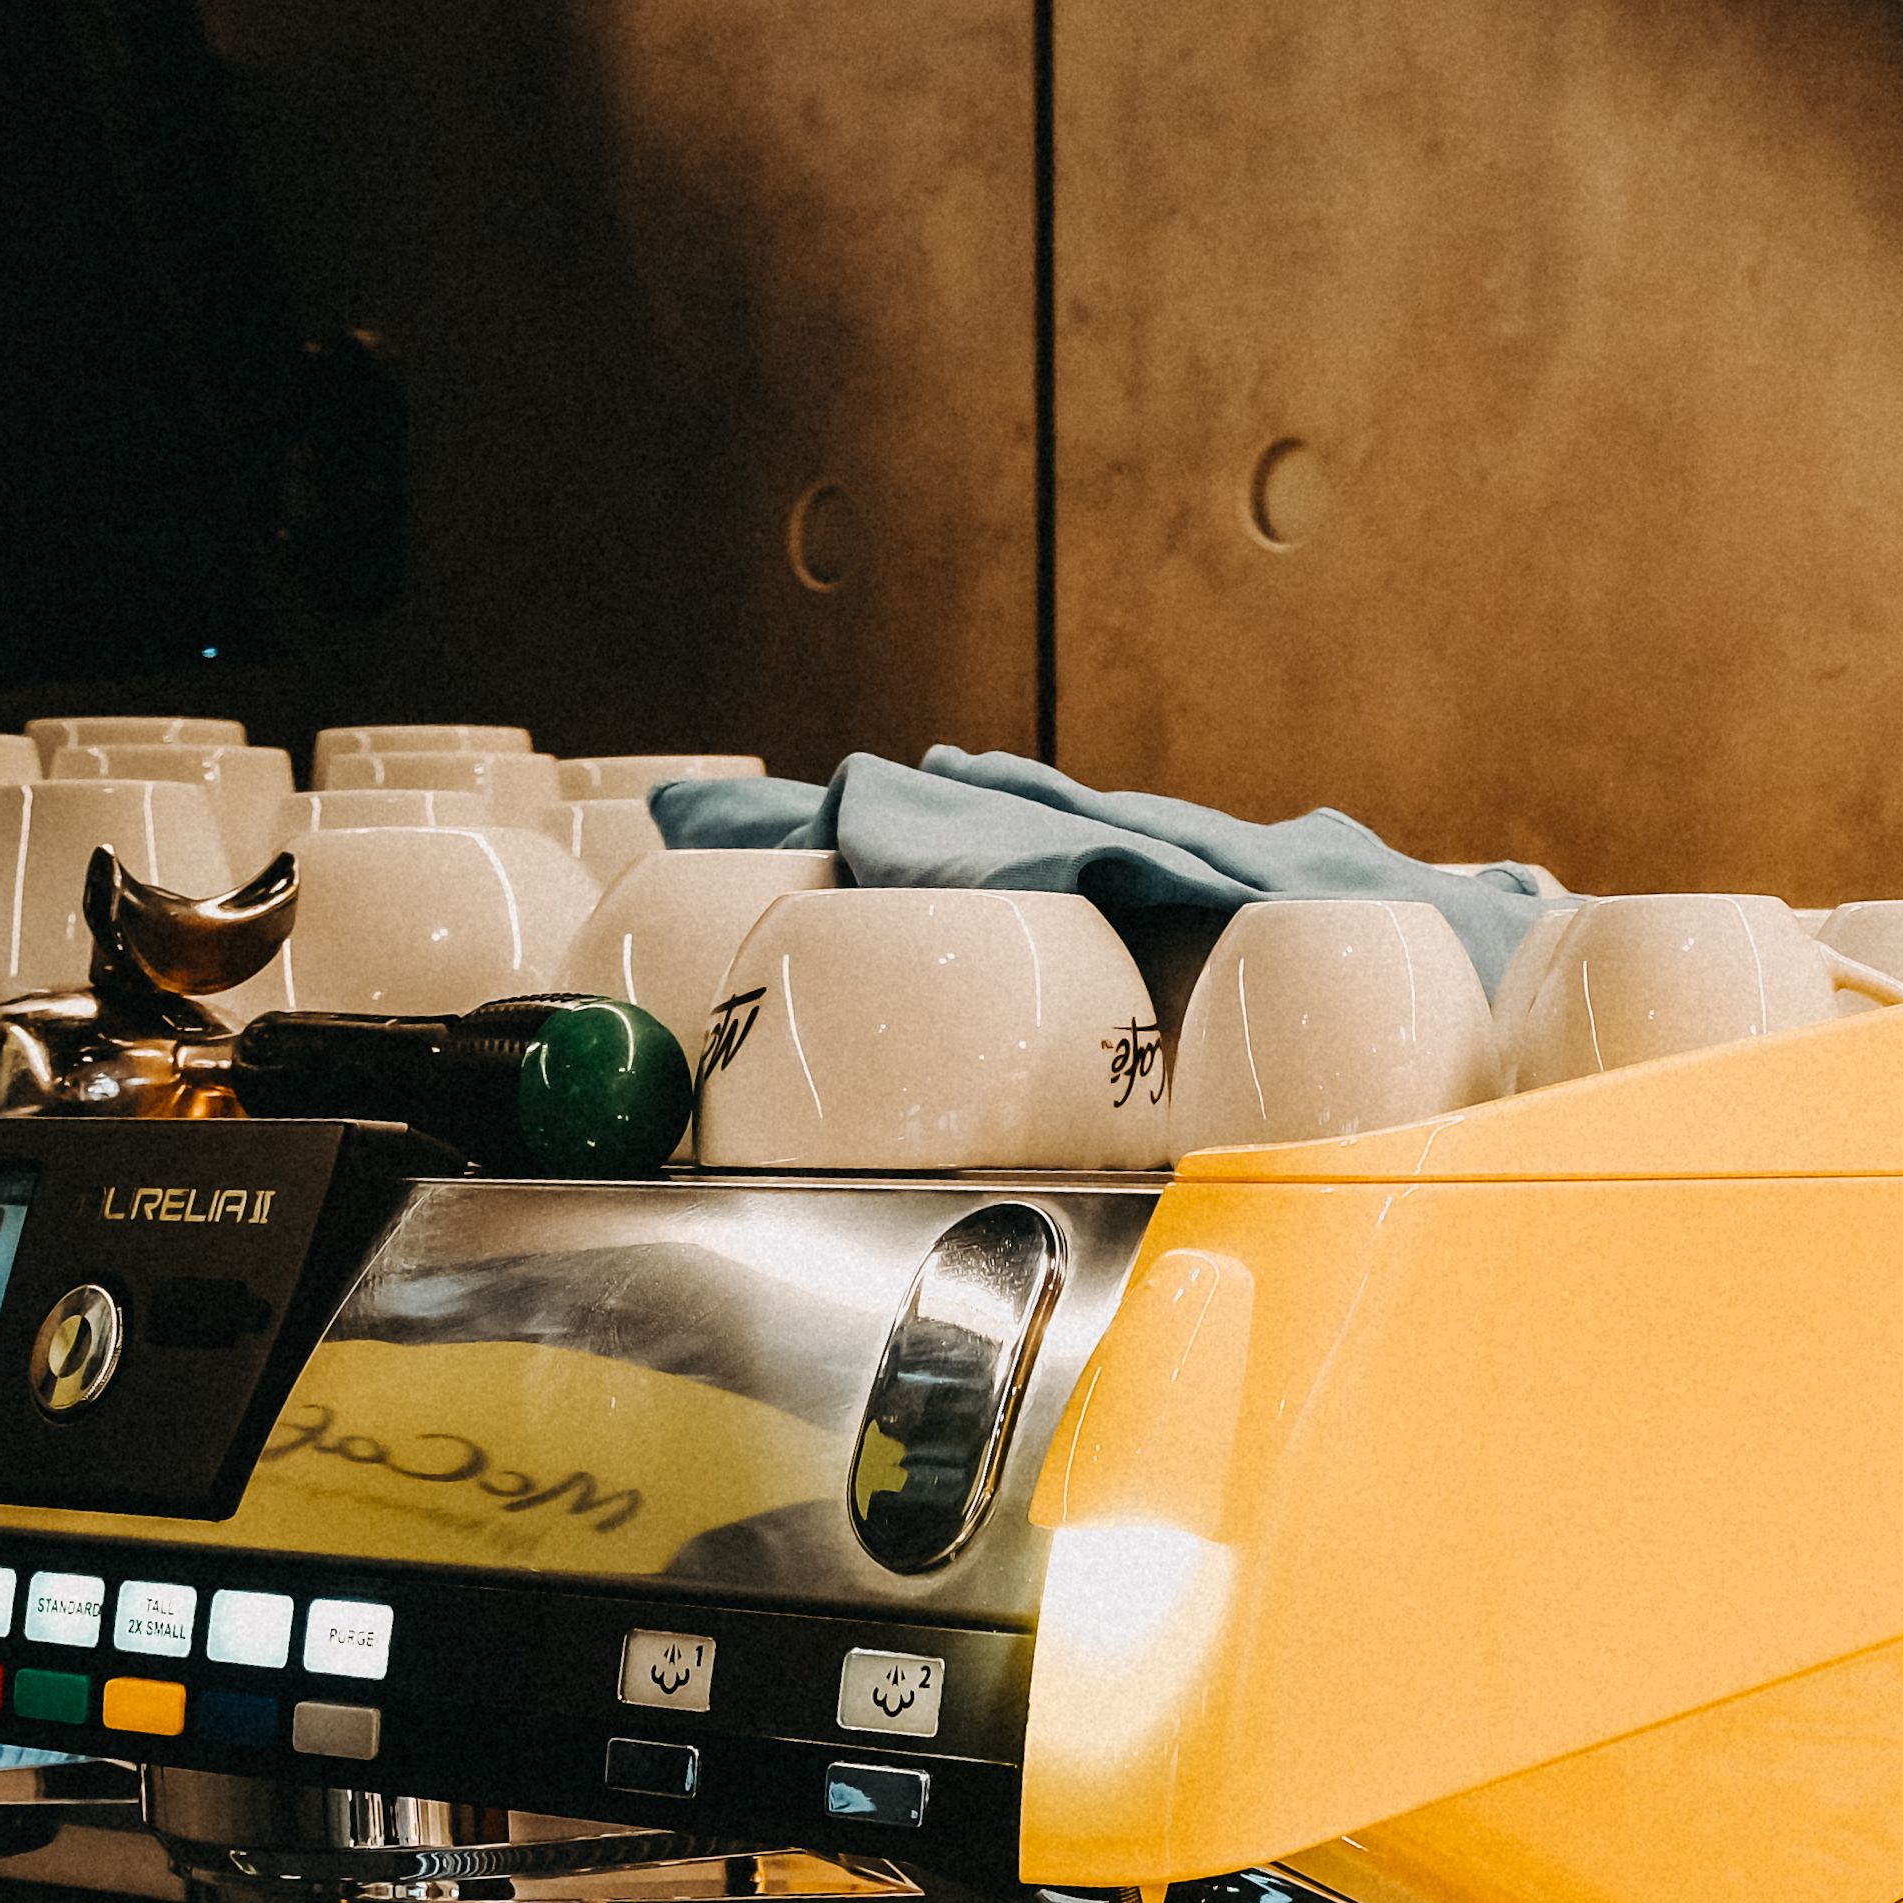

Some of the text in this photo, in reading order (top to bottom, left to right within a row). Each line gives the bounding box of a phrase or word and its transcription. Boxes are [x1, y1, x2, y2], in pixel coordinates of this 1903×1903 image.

[36, 1595, 103, 1619] STANDARD
[144, 1597, 176, 1617] TALL
[127, 1618, 187, 1642] 2X SMALL
[328, 1627, 376, 1649] PURGE
[694, 1645, 705, 1668] 1
[918, 1665, 932, 1689] 2
